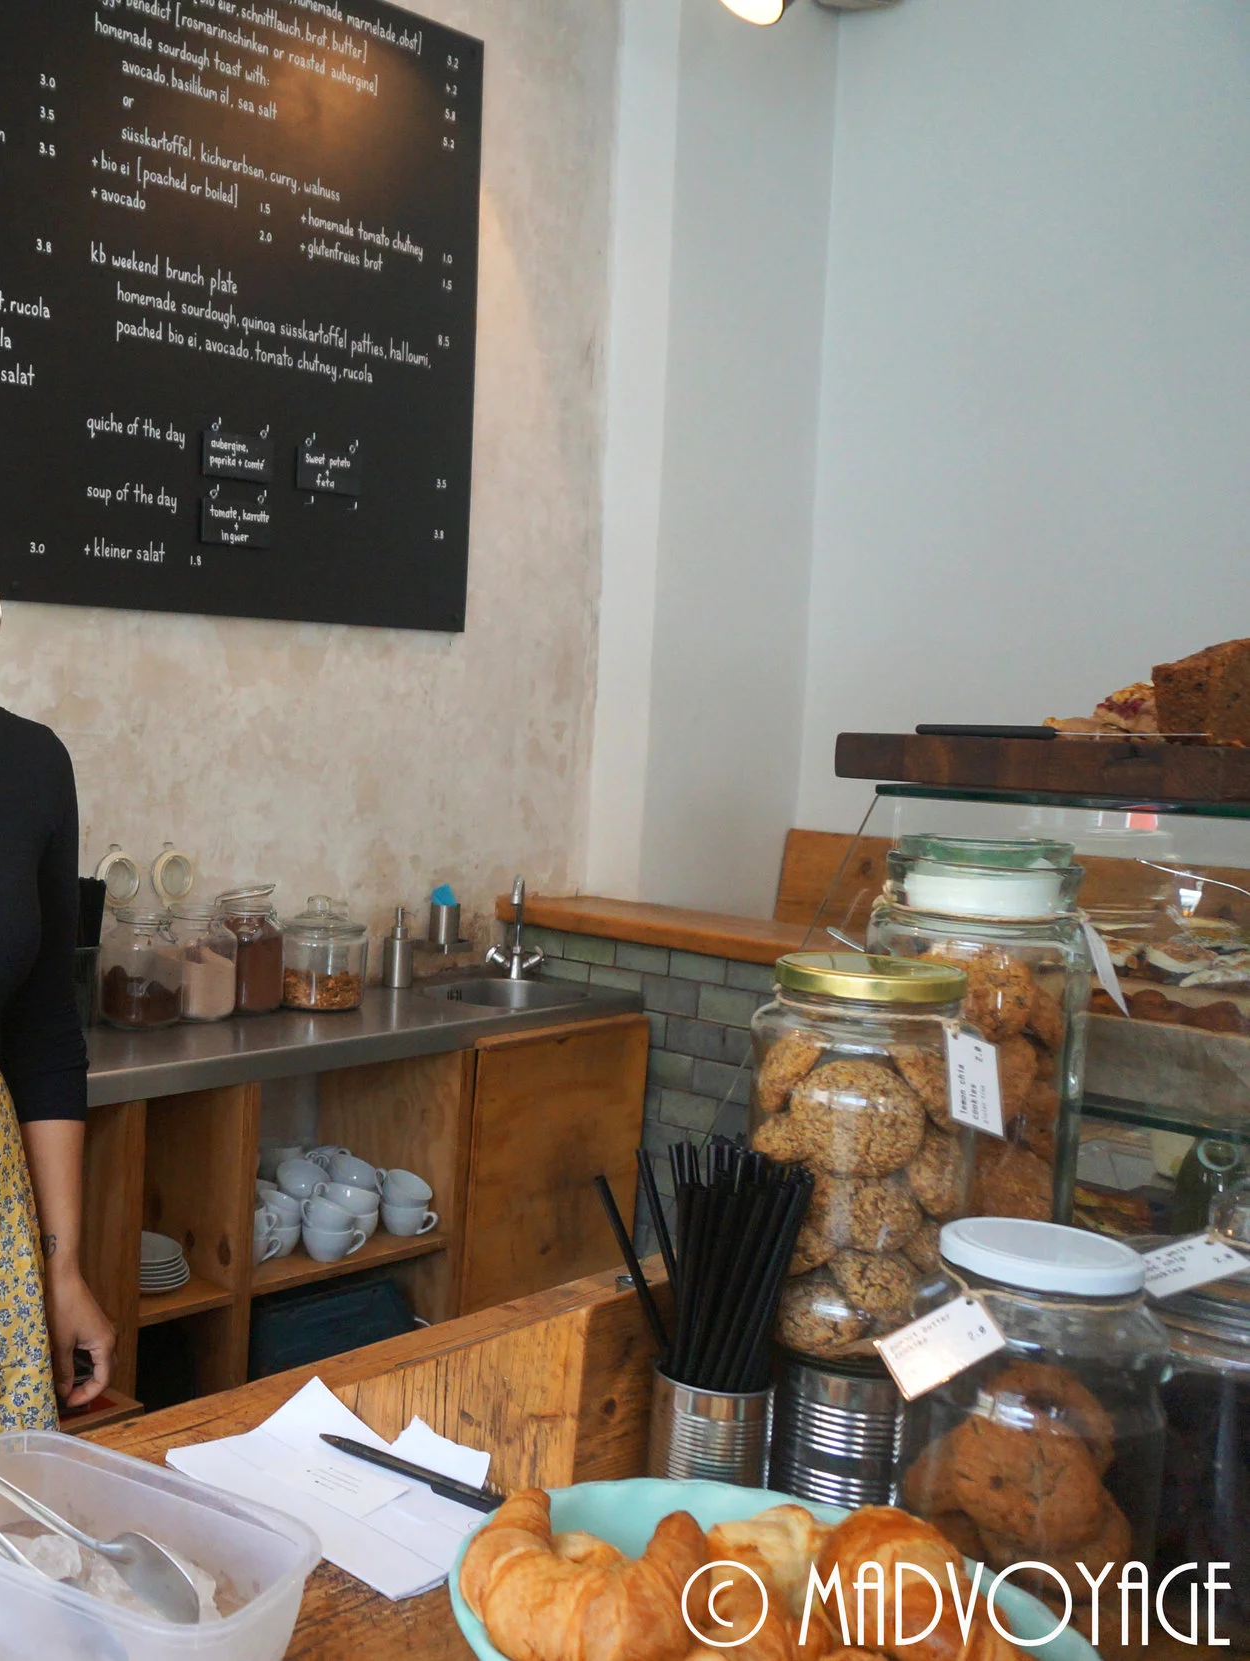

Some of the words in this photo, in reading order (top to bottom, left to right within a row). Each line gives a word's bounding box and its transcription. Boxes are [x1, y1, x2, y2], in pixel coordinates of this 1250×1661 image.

[94, 12, 153, 50] homemade
[158, 41, 210, 71] sourdough
[213, 51, 242, 78] toast
[272, 46, 284, 60] or
[288, 53, 326, 76] roasted
[446, 54, 459, 70] 3.2
[39, 74, 56, 89] 3.0
[122, 95, 135, 109] or
[171, 67, 217, 102] basilikum
[238, 97, 255, 114] sea
[258, 101, 278, 120] salt
[39, 106, 55, 121] 3.5
[39, 142, 56, 157] 3.5
[120, 162, 130, 176] ei
[190, 182, 202, 195] or
[303, 178, 341, 202] walnuss
[260, 202, 271, 215] 1.5
[36, 238, 52, 254] 3.8
[259, 230, 272, 243] 2.0
[357, 221, 390, 246] tomato
[392, 231, 424, 263] chutney
[90, 240, 107, 264] kb
[111, 249, 159, 276] weekend
[165, 256, 205, 286] brunch
[210, 268, 238, 297] plate
[363, 249, 384, 272] brot
[9, 297, 51, 319] rucola
[116, 280, 177, 312] homemade
[241, 316, 276, 336] quinoa
[280, 318, 348, 349] süsskartoffel
[116, 318, 163, 343] poached
[168, 322, 184, 345] bio
[254, 340, 294, 367] tomato
[0, 364, 35, 386] salat
[86, 412, 123, 439] quiche
[126, 417, 140, 435] of
[142, 419, 161, 440] the
[166, 422, 186, 449] day
[209, 455, 237, 469] paprika
[329, 456, 351, 470] potato
[86, 485, 112, 506] soup
[116, 482, 130, 501] of
[133, 484, 153, 504] the
[157, 486, 178, 514] day
[29, 542, 46, 554] 3.0
[136, 540, 166, 563] salat
[959, 1089, 968, 1115] lemon
